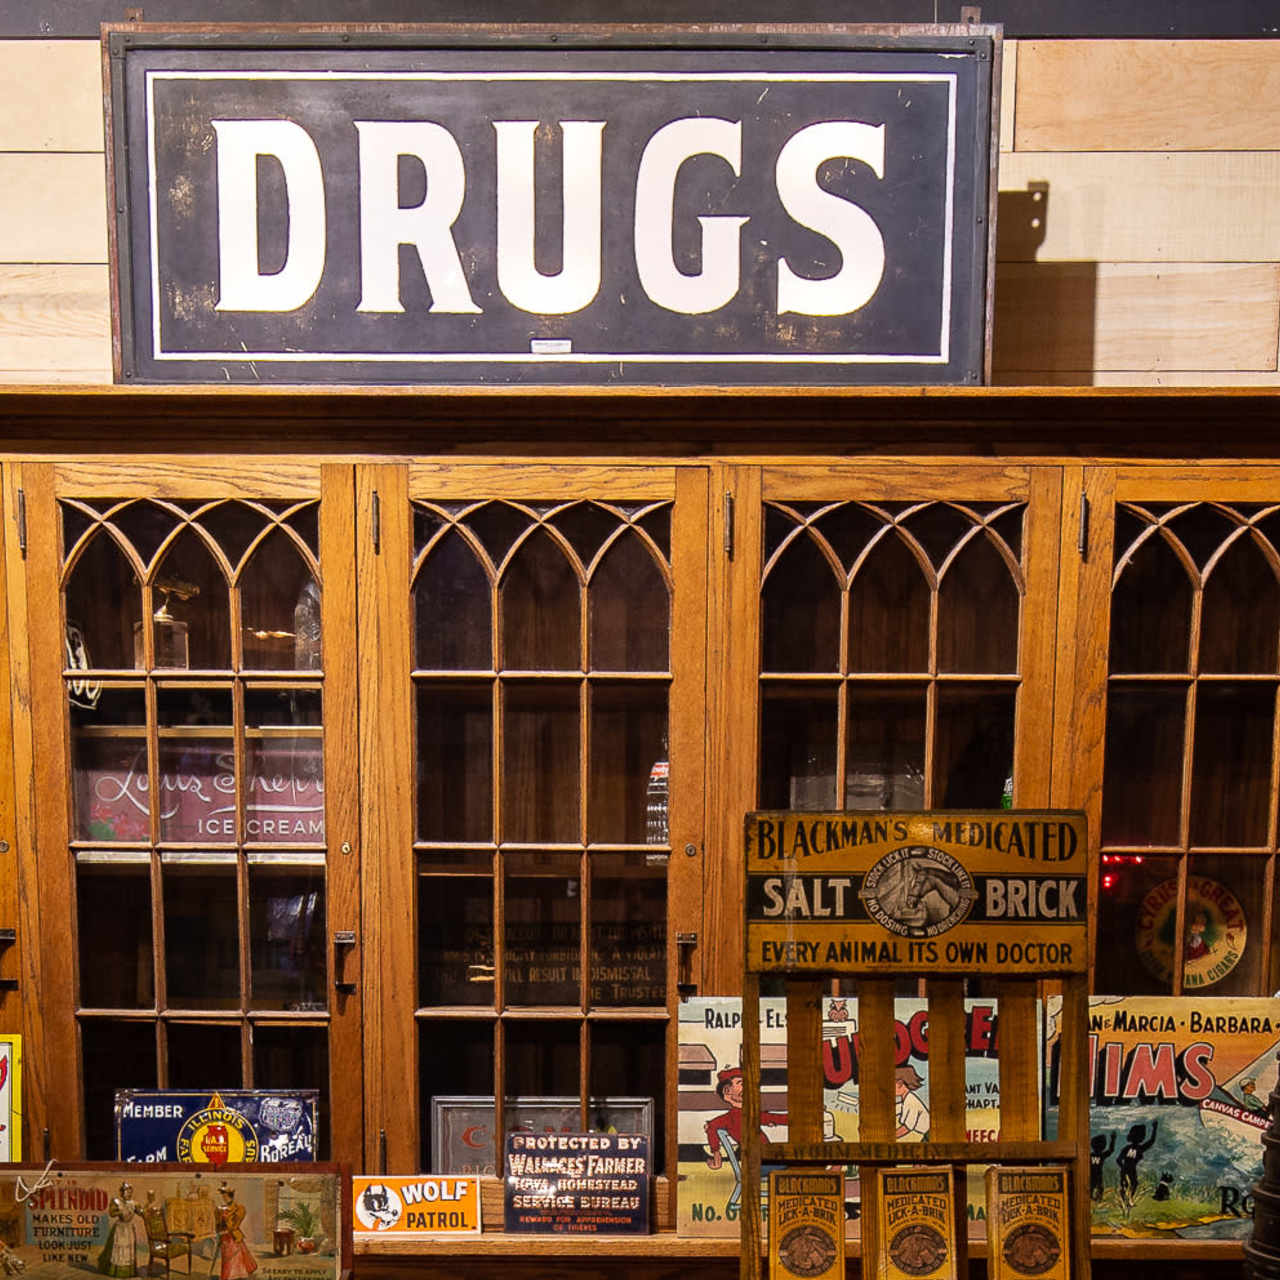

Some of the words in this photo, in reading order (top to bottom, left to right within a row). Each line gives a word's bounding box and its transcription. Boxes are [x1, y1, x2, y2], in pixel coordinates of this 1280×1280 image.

[211, 116, 887, 316] DRUGS
[198, 820, 235, 834] ICE
[247, 819, 325, 835] CREAM
[758, 820, 908, 860] BLACKMAN'S
[932, 820, 1078, 862] MEDICATED
[763, 878, 851, 917] SALT
[985, 879, 1078, 918] BRICK
[875, 911, 908, 935] DOSING
[762, 941, 820, 963] EVERY
[825, 941, 902, 963] ANIMAL
[909, 942, 938, 963] ITS
[945, 942, 987, 964] OWN
[996, 943, 1072, 964] DOCTOR
[1207, 950, 1239, 980] CIGARS
[1113, 1011, 1176, 1033] MARCIA
[1190, 1012, 1272, 1034] BARBARA
[122, 1102, 183, 1118] MEMBER
[1202, 1099, 1242, 1120] CANVAS
[187, 1109, 246, 1131] ILLINOIS
[513, 1137, 611, 1150] PROTECTED
[617, 1137, 641, 1150] BY
[587, 1154, 646, 1177] FARMER
[400, 1181, 468, 1204] WOLF
[557, 1179, 638, 1191] HOMESTEAD
[29, 1187, 109, 1211] SPLENDID
[513, 1195, 575, 1208] SERVICE
[580, 1196, 640, 1209] BUREAU
[777, 1196, 838, 1212] MEDICATED
[887, 1196, 946, 1211] MEDICATED
[1001, 1195, 1061, 1211] MEDICATED
[32, 1214, 73, 1224] MAKES
[77, 1214, 100, 1225] OLD
[406, 1210, 469, 1228] PATROL
[33, 1227, 100, 1238] FURNITURE
[39, 1240, 65, 1250] LOOK
[68, 1240, 92, 1250] JUST
[42, 1253, 65, 1262] LIKE
[68, 1253, 89, 1262] NEW
